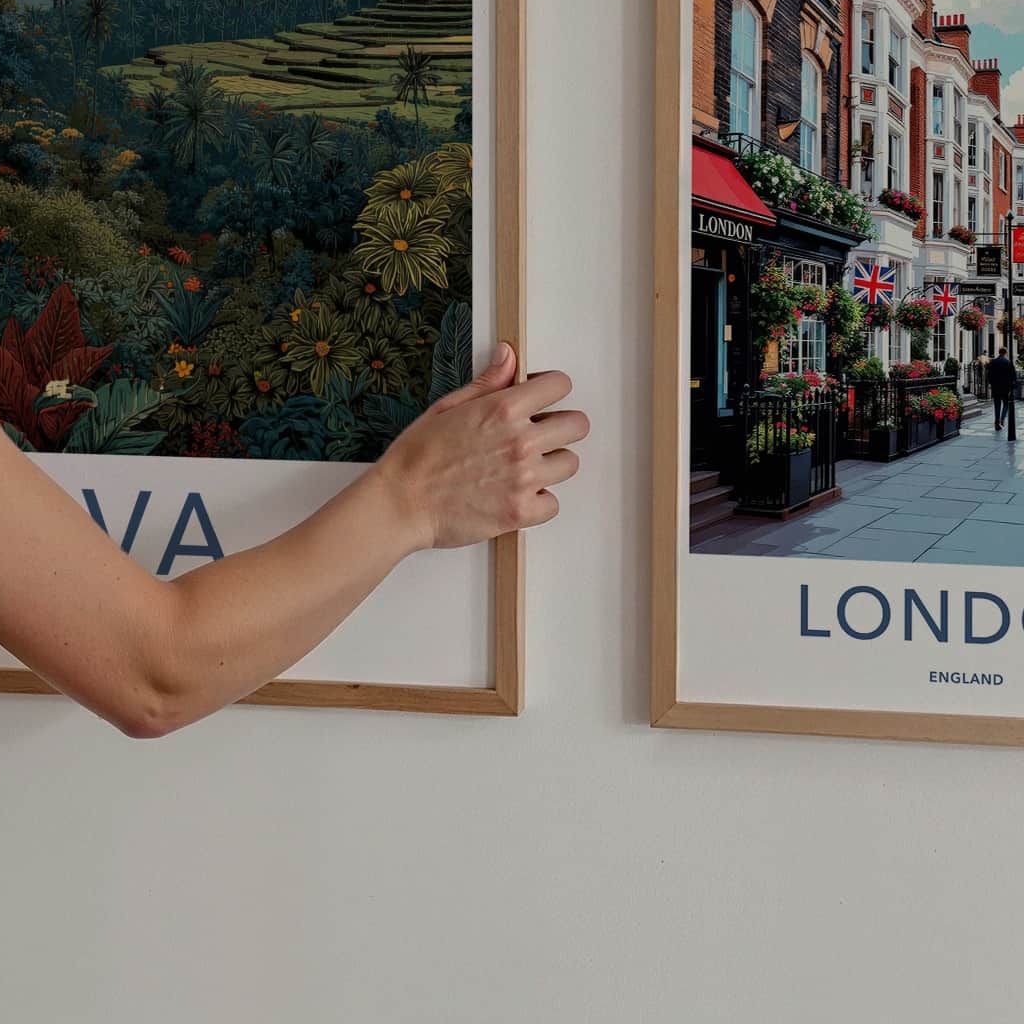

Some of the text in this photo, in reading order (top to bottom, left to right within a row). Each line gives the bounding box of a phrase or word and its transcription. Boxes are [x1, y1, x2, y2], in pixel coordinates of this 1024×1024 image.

[699, 214, 753, 242] LONDON
[801, 585, 1024, 645] LOND
[929, 671, 1004, 686] ENGLAND
